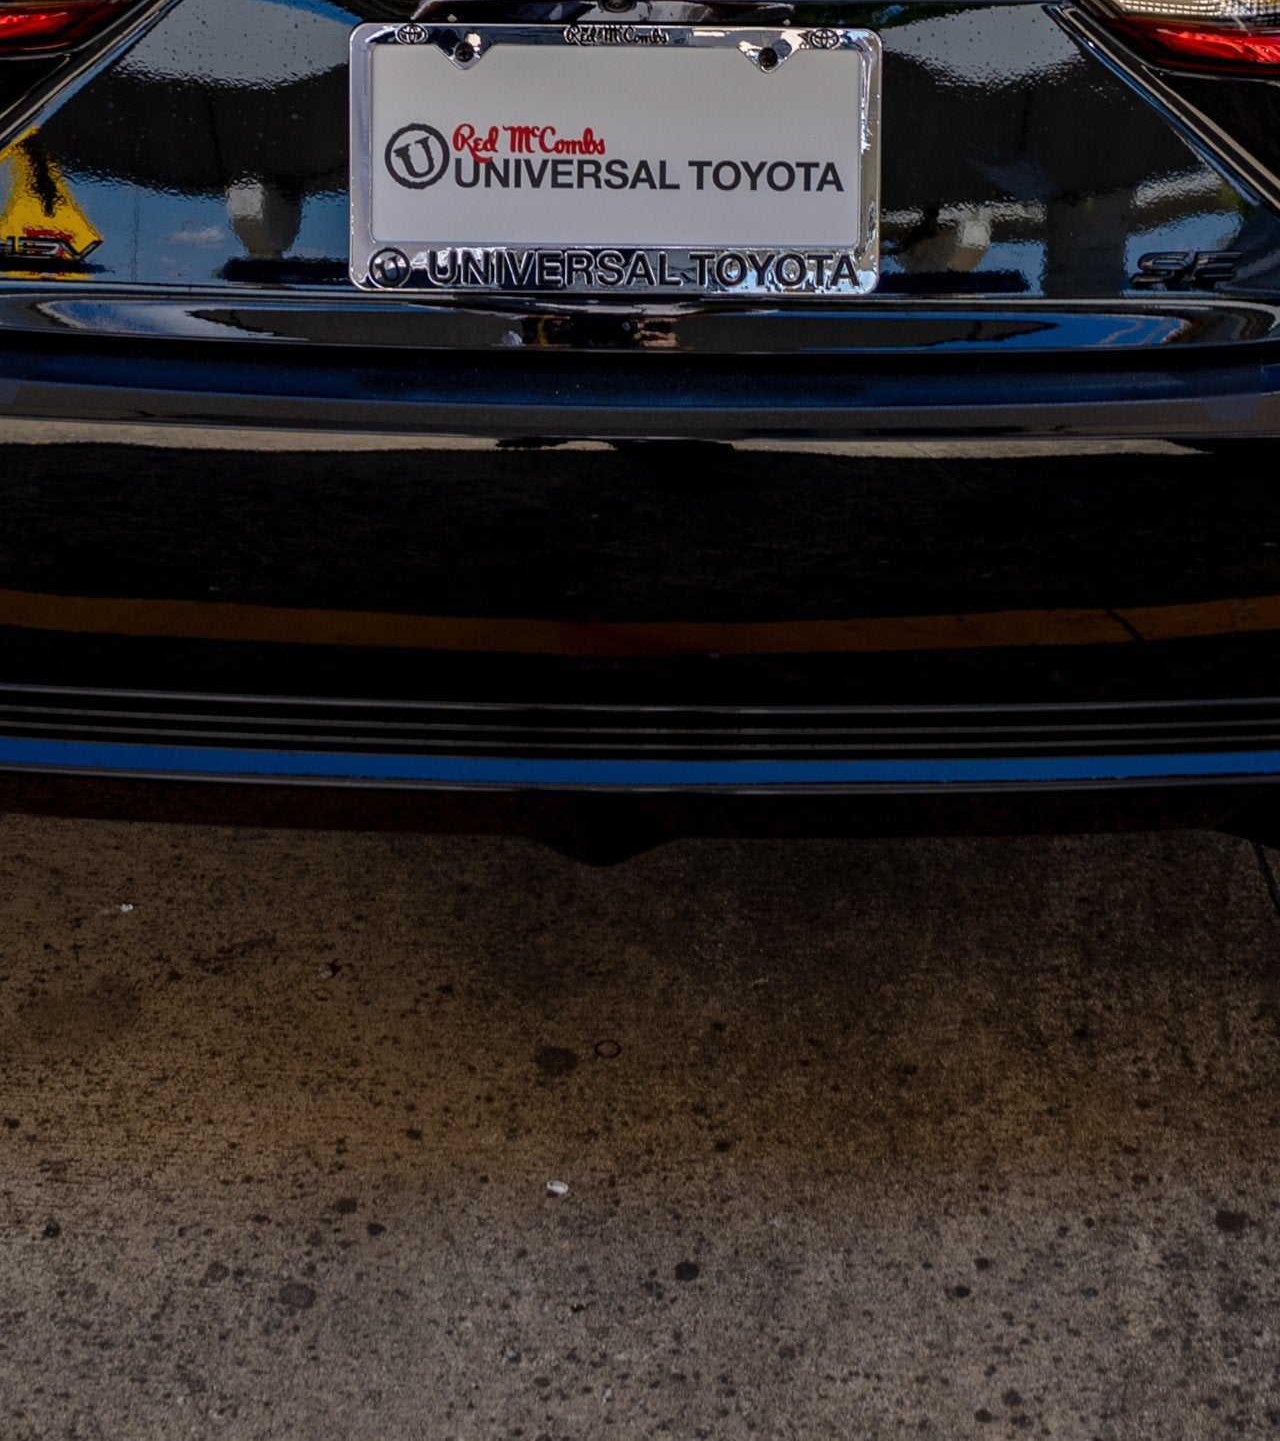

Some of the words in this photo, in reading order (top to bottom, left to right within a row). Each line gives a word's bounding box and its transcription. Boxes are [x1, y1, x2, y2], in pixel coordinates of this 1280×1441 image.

[452, 122, 499, 164] Red
[502, 123, 606, 156] McCombs
[454, 157, 680, 190] UNIVERSAL
[688, 160, 845, 192] TOYOTA
[426, 248, 685, 286] UNIVERSAL
[688, 250, 862, 288] TOYOTA
[1130, 250, 1244, 284] SE
